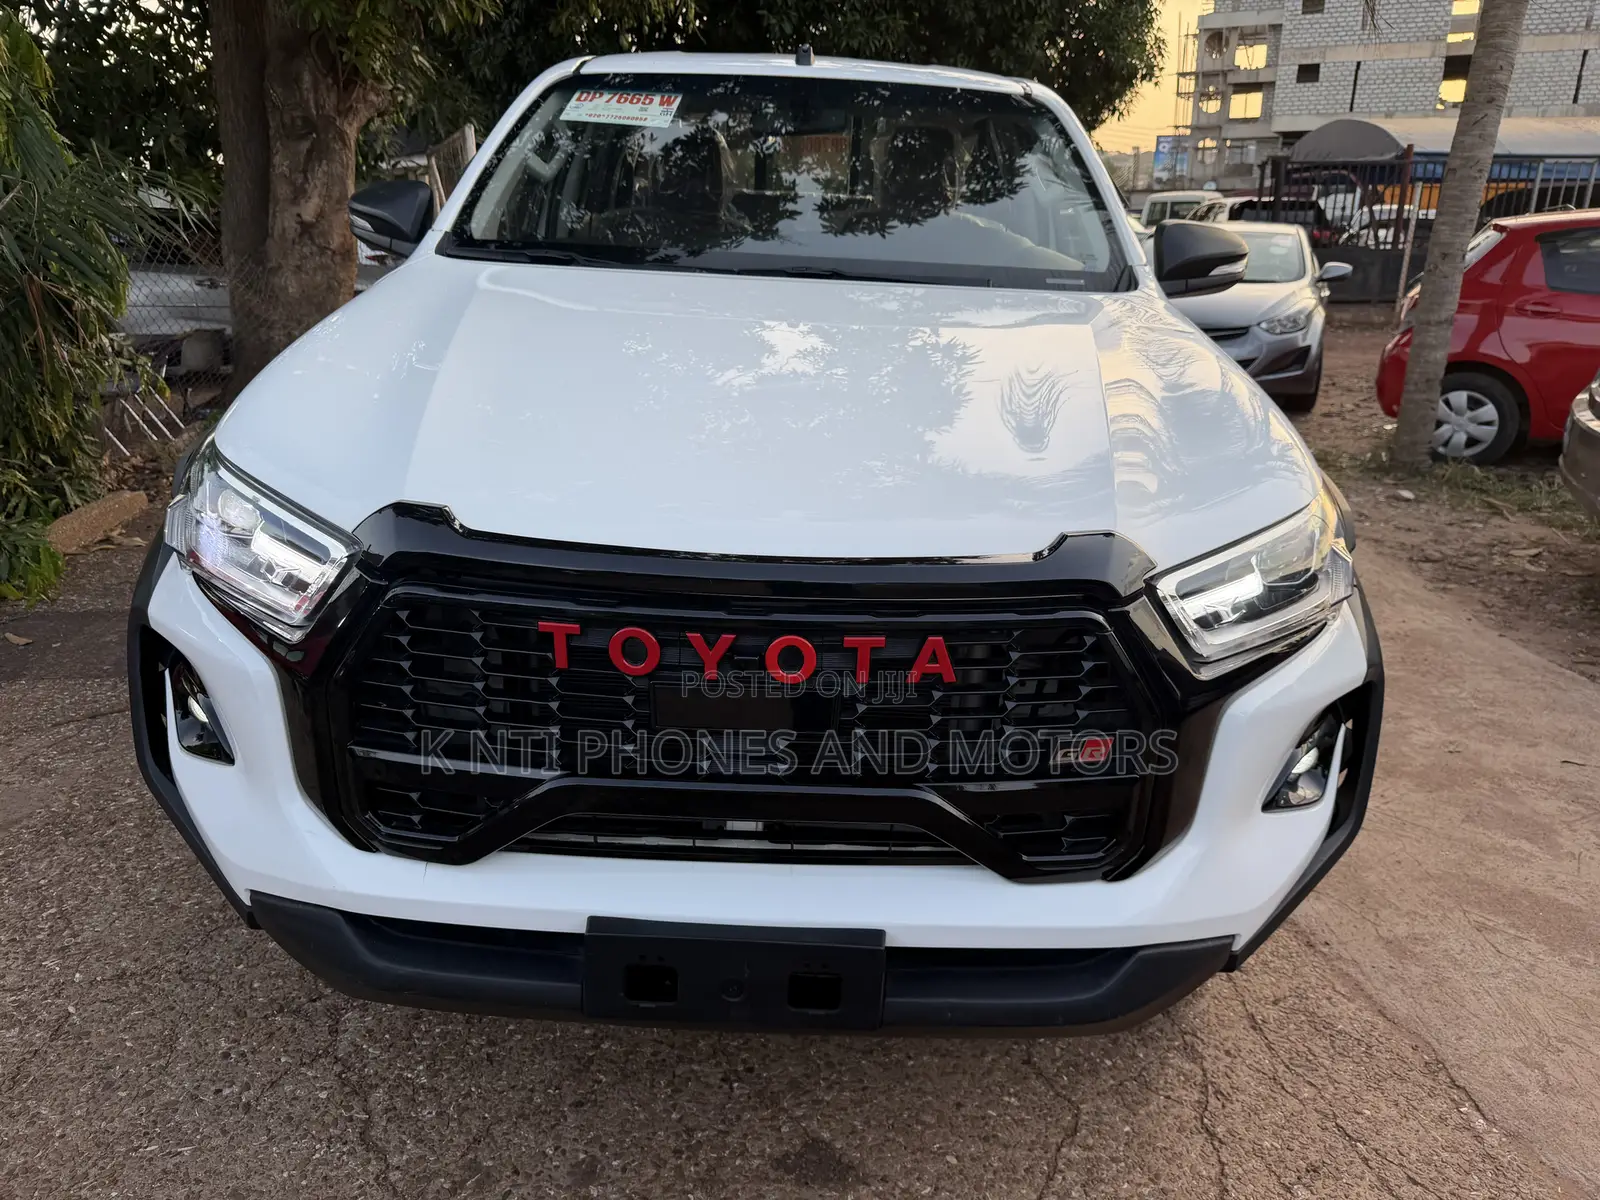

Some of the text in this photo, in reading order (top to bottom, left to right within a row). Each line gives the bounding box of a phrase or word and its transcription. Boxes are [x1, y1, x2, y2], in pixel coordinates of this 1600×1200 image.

[575, 90, 679, 107] DP 7665 W
[537, 621, 957, 684] TOYOTA
